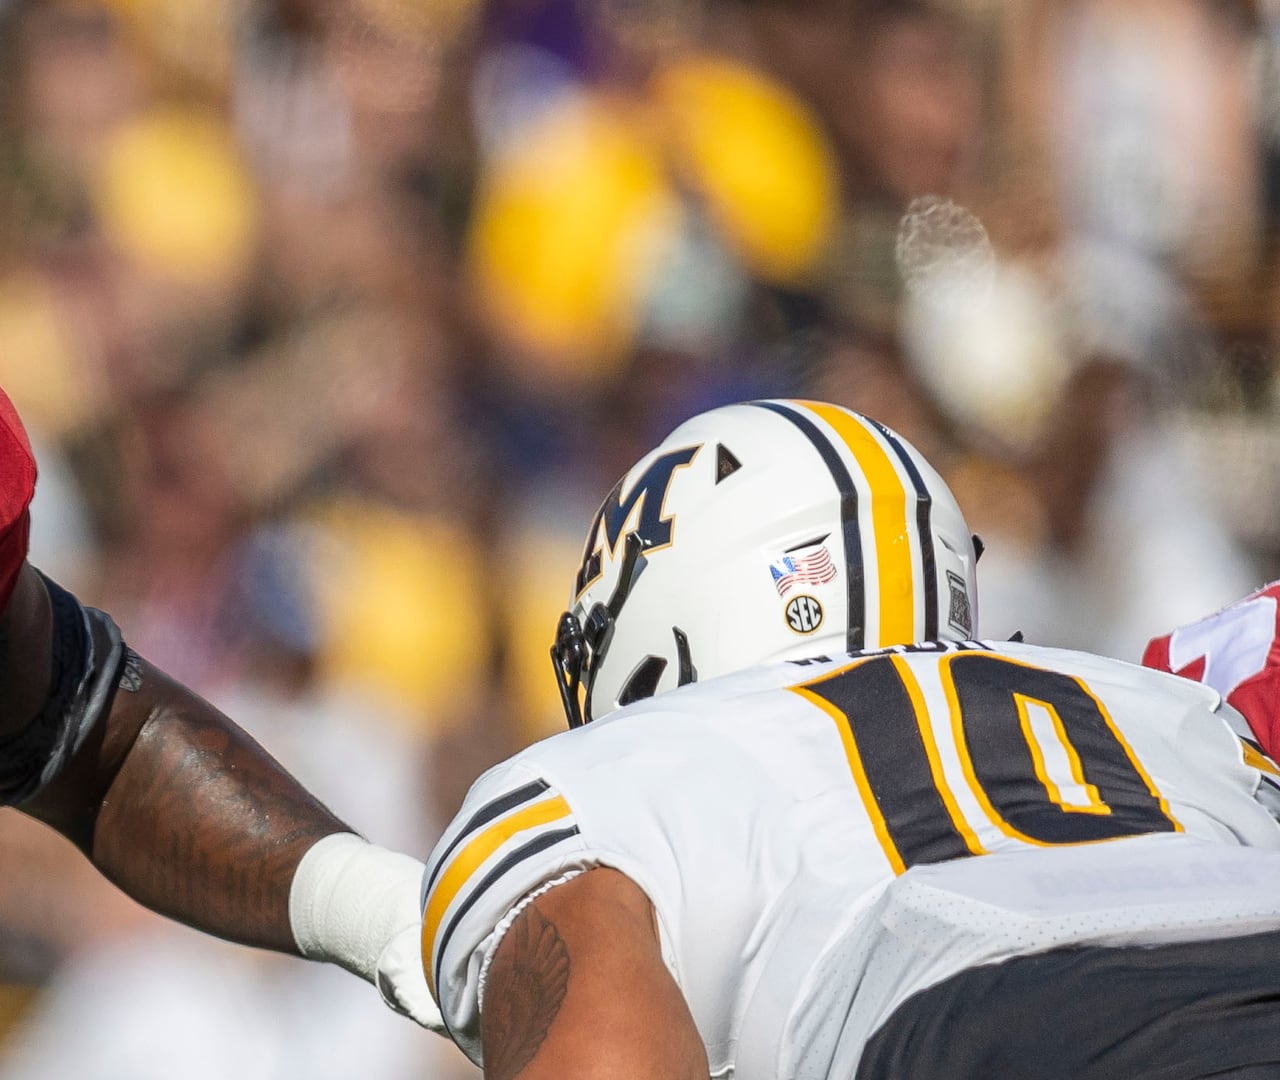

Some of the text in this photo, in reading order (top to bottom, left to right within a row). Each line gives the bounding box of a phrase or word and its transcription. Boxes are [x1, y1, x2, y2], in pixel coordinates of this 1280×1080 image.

[574, 442, 705, 602] M
[787, 595, 823, 634] SEC
[784, 650, 1185, 877] 10
